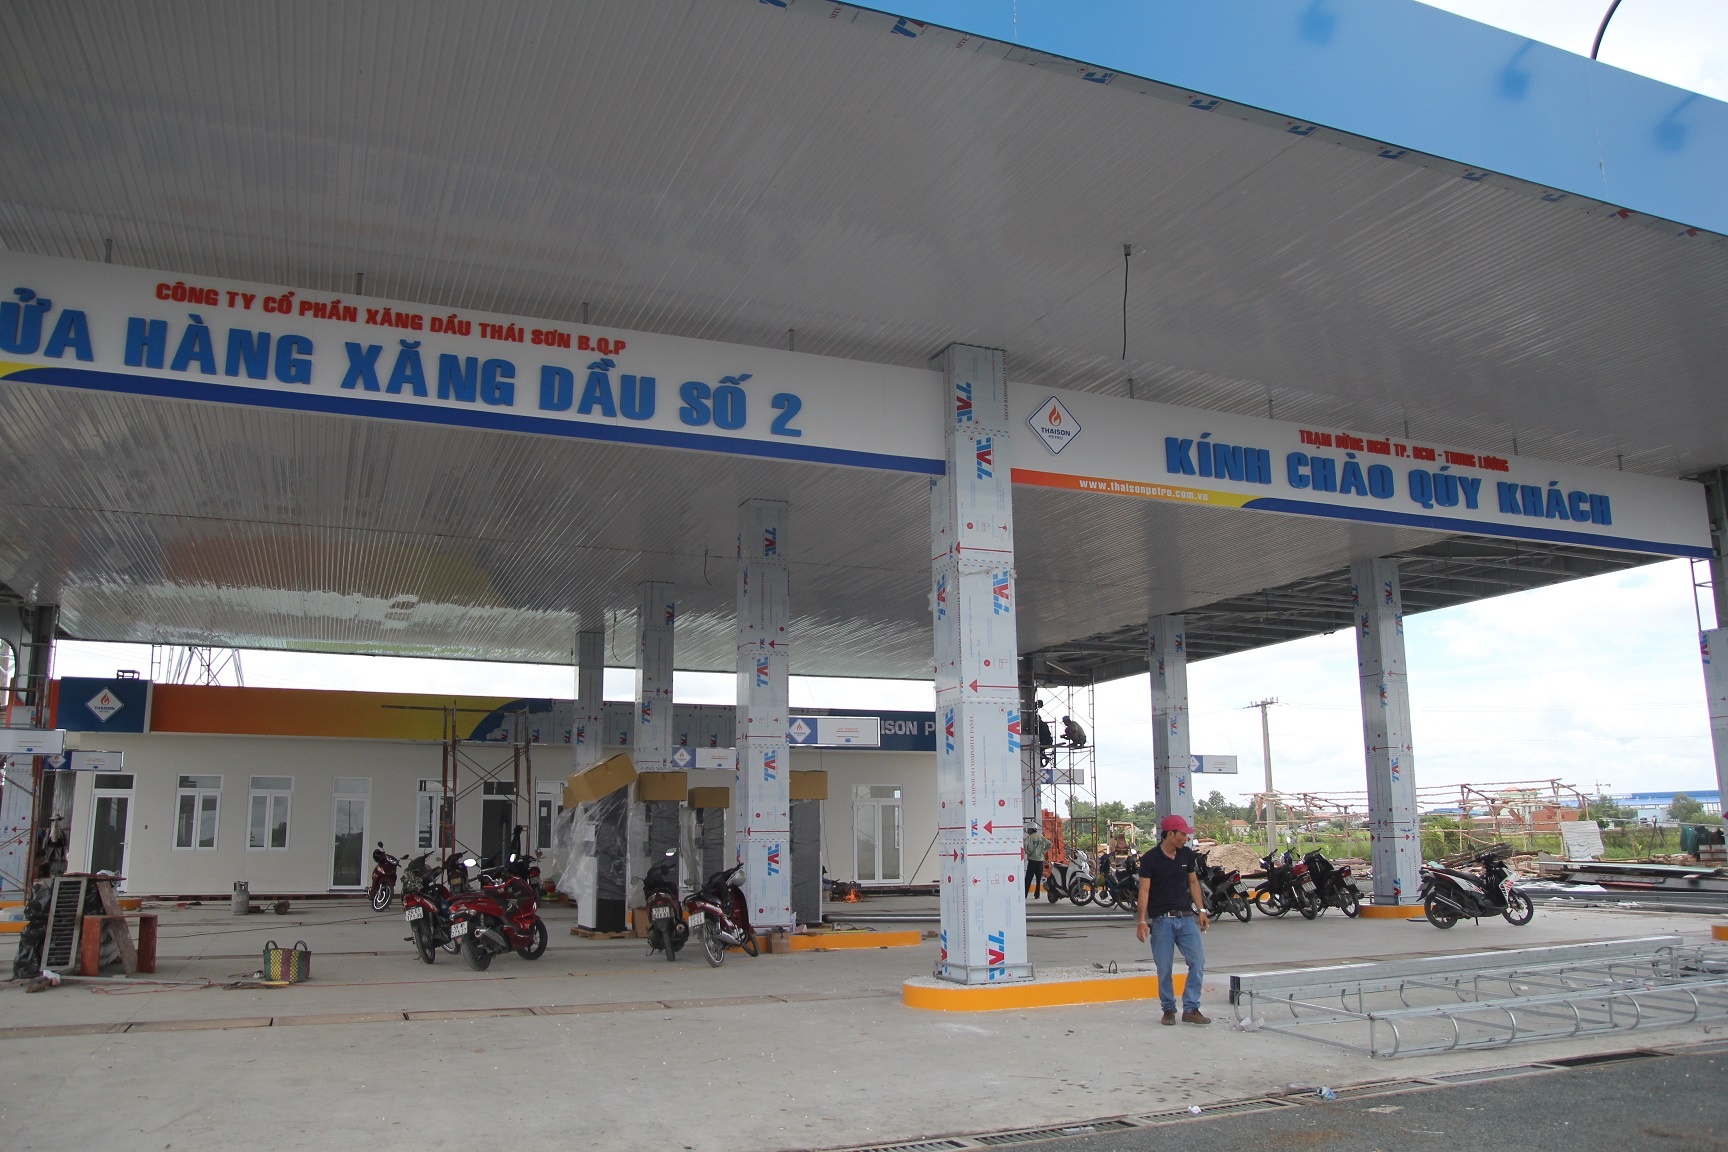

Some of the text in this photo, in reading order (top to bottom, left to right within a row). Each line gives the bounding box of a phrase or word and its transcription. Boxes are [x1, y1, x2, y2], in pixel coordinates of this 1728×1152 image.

[155, 281, 219, 306] CÔNG
[228, 291, 256, 310] TY
[263, 290, 295, 315] CỔ
[365, 309, 424, 331] XĂNG
[479, 323, 524, 343] THÁI
[531, 328, 571, 349] SƠN
[577, 335, 627, 356] B.Q.P
[0, 287, 802, 438] ỬA HÀNG XĂNG DẦU SỐ 2
[1040, 426, 1071, 438] THAISON
[1298, 429, 1333, 449] TRẠM
[1393, 443, 1411, 458] TP.
[1078, 478, 1209, 502] www.thaisonpetro.com.vn
[1164, 431, 1613, 526] KÍNH CHÀO QÚY KHÁCH
